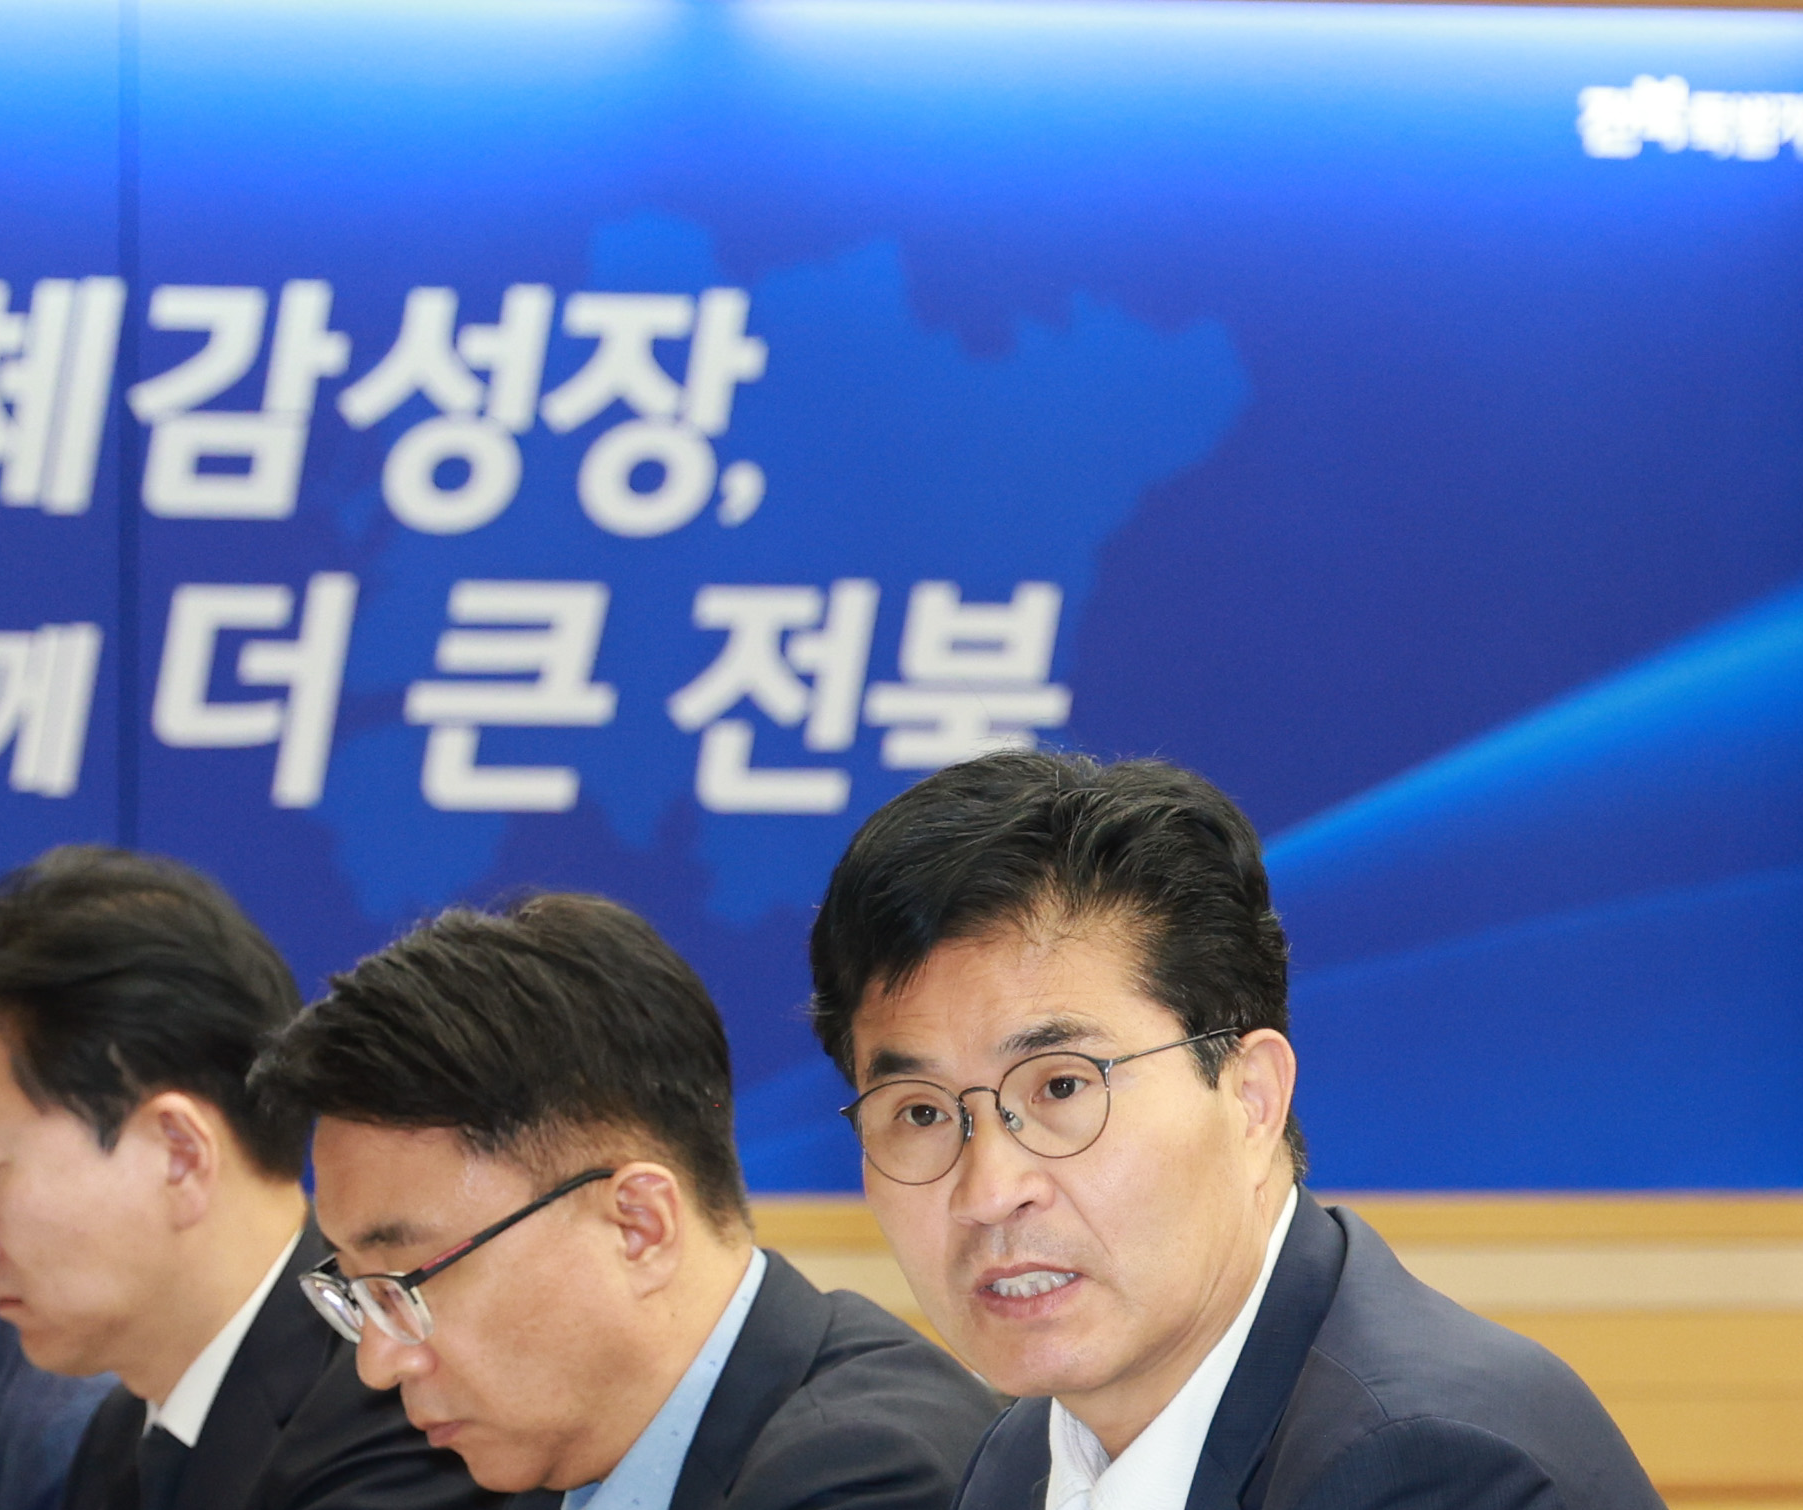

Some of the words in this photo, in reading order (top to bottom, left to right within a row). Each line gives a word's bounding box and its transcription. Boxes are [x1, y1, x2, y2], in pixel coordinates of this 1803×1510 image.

[151, 571, 357, 808] 더
[404, 580, 616, 812] 큰
[669, 578, 1071, 814] 전북
